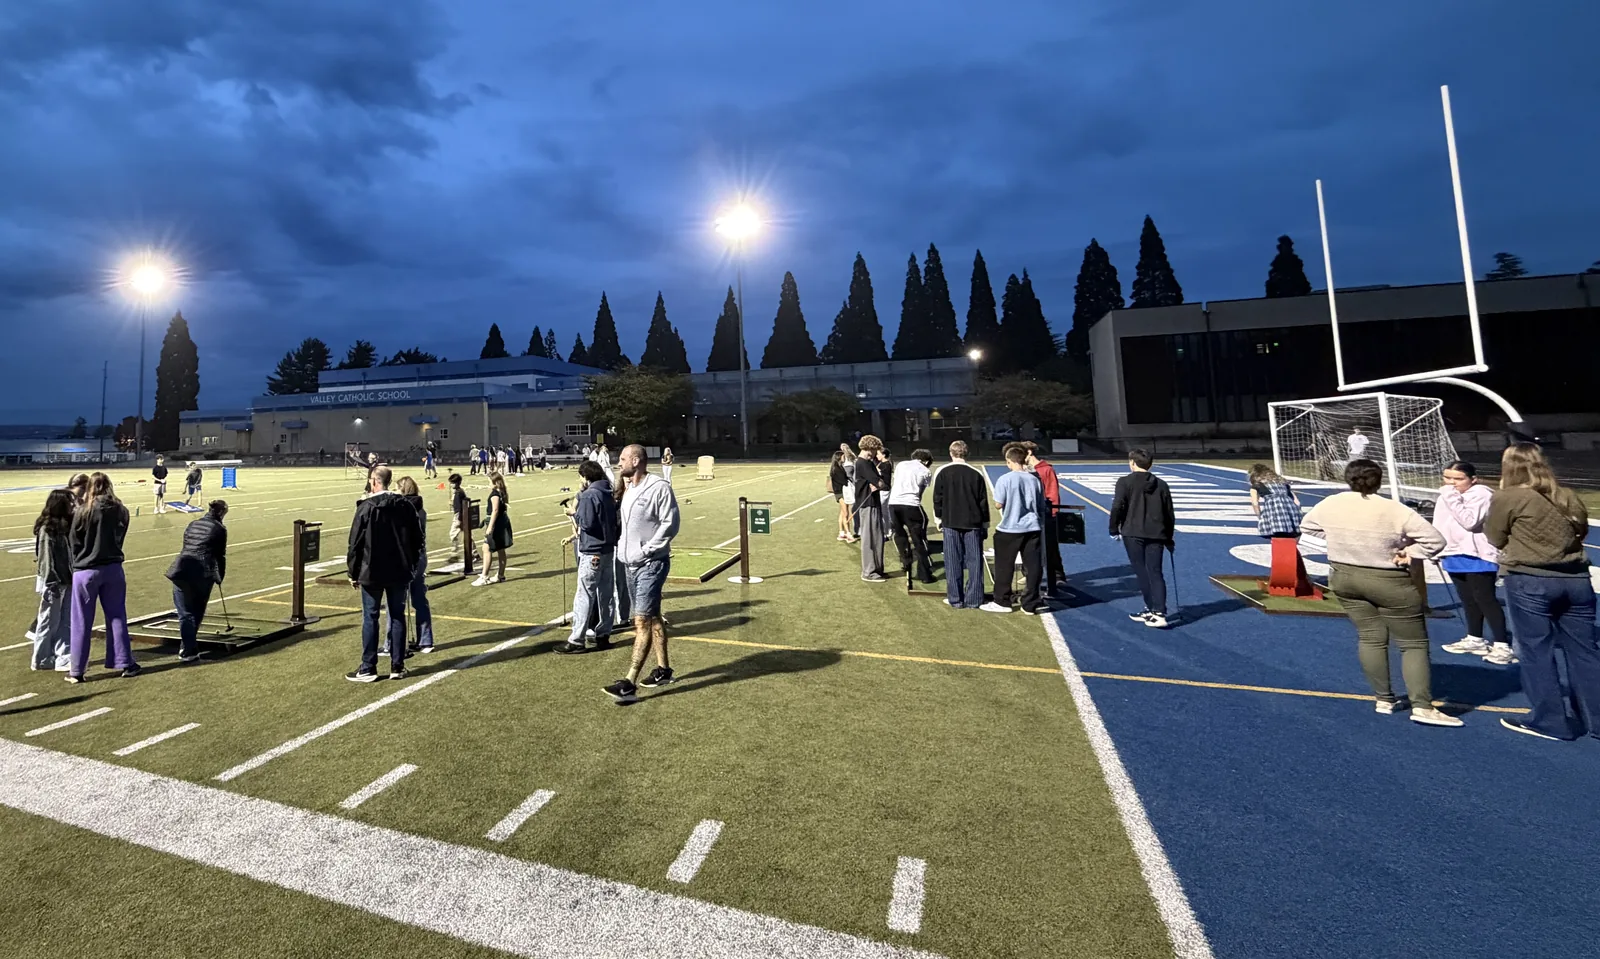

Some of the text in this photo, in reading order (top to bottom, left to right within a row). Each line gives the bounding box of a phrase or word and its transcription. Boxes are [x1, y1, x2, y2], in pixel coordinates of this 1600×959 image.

[311, 390, 411, 404] VALLEY CATHOLIC SCHOOL
